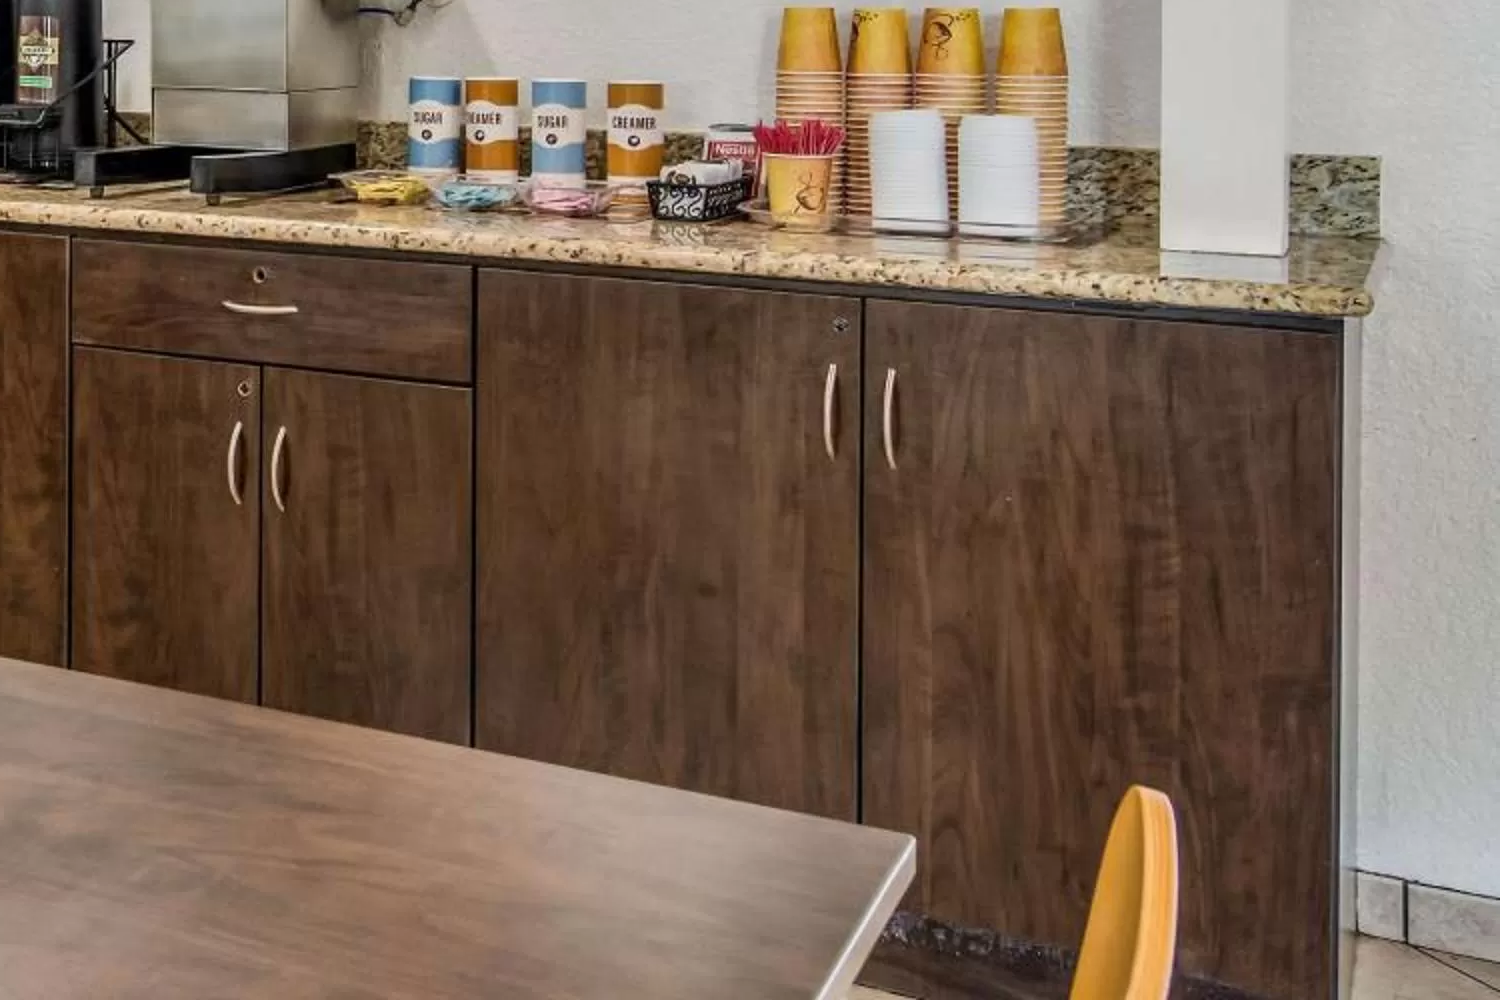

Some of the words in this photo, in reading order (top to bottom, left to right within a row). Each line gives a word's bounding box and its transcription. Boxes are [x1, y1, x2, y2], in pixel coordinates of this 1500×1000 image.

[413, 111, 444, 125] SUGAR
[537, 115, 568, 129] SUGAR
[612, 115, 656, 130] CREAMER
